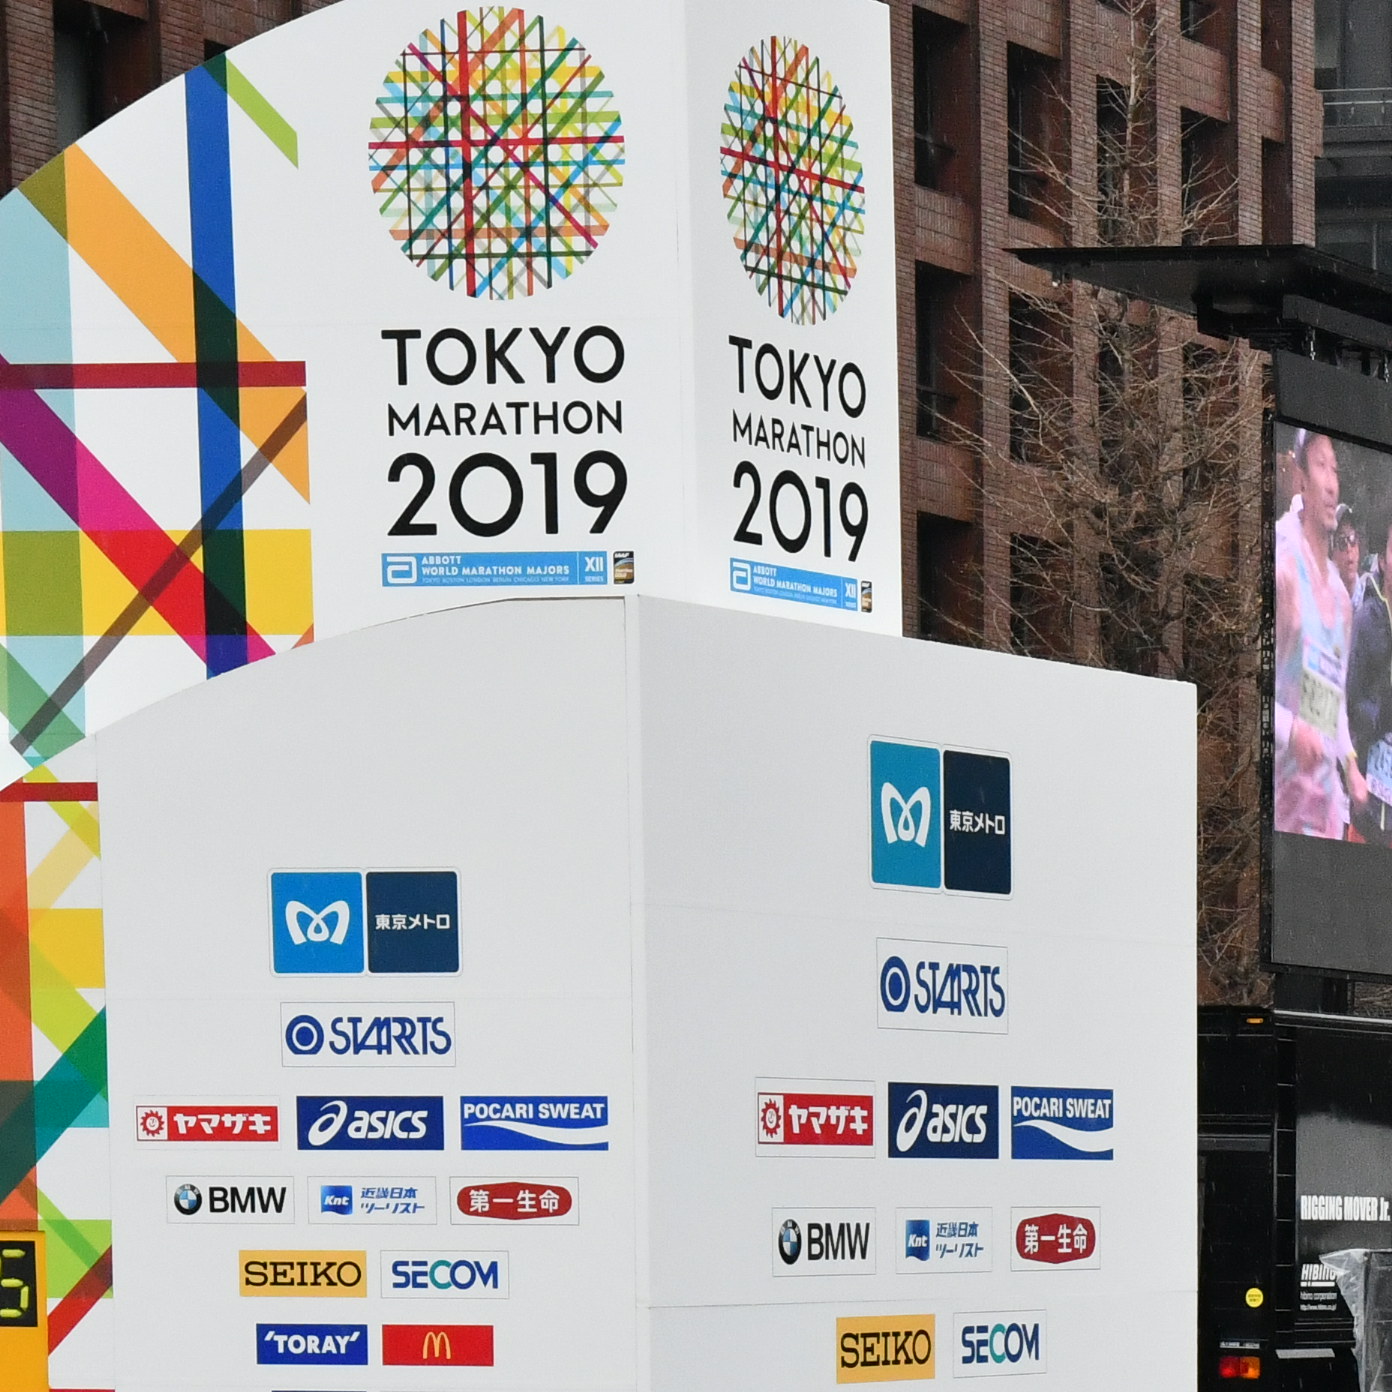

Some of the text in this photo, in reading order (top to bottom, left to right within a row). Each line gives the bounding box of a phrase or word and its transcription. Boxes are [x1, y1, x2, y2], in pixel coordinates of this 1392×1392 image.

[382, 326, 625, 386] TOKYO
[729, 335, 866, 419] TOKYO
[389, 402, 622, 436] MARATHON
[733, 410, 866, 468] MARATHON
[387, 453, 627, 538] 2019
[733, 461, 869, 563] 2019
[422, 556, 461, 565] ABBOTT
[422, 565, 569, 576] WORLD MARATHON MAJORS
[585, 557, 603, 572] XII
[753, 565, 777, 576] ABBOTT
[753, 578, 776, 587] WORLD
[776, 580, 811, 592] MARATHON
[813, 586, 837, 597] MAJORS
[949, 810, 1005, 835] 東京メトロ
[375, 914, 450, 930] 東京メトロ
[914, 961, 1005, 1018] STARTS
[329, 1016, 452, 1055] STARTS
[464, 1103, 605, 1120] POCARI SWEAT
[789, 1104, 868, 1135] ヤマザキ
[1013, 1096, 1111, 1119] POCARI SWEAT
[174, 1114, 272, 1135] ヤマザキ
[348, 1110, 428, 1139] asics
[927, 1104, 988, 1143] asics
[209, 1187, 287, 1214] BMW
[323, 1196, 350, 1208] Knt
[360, 1187, 418, 1200] 近畿日本
[469, 1190, 560, 1213] 第一生命
[360, 1202, 425, 1215] ツーリスト
[1300, 1195, 1343, 1220] RIGGING
[1343, 1196, 1378, 1221] MOVER
[807, 1223, 870, 1260] BMW
[935, 1221, 979, 1238] 近畿日本
[1024, 1224, 1088, 1255] 第一生命
[935, 1242, 984, 1259] ツーリスト
[245, 1261, 362, 1287] SEIKO
[392, 1259, 498, 1289] SECOM
[840, 1329, 932, 1369] SEIKO
[961, 1322, 1039, 1364] SECOM
